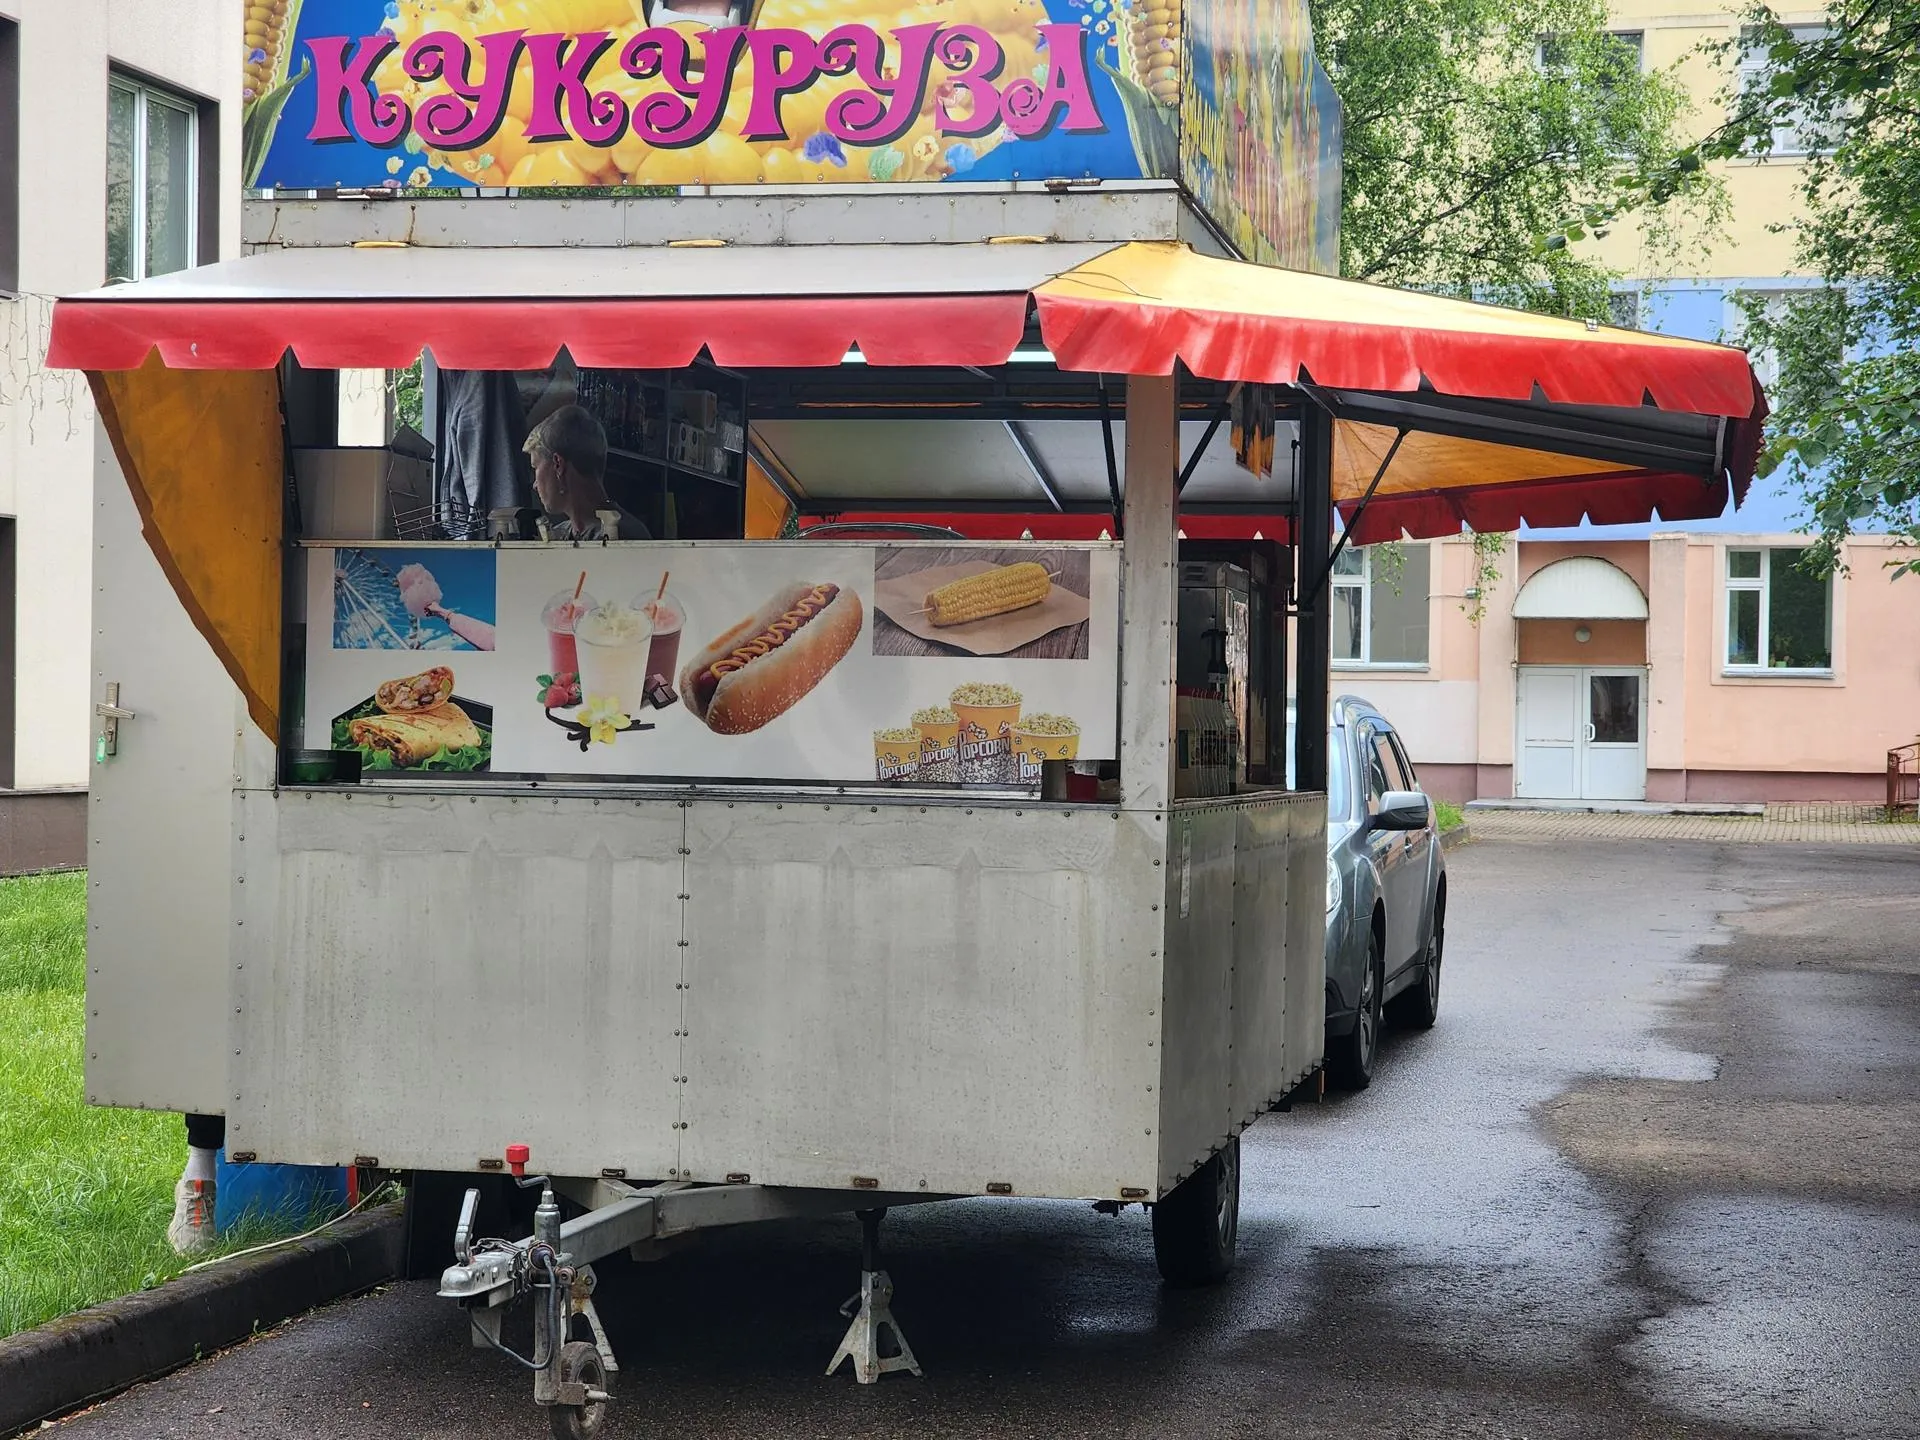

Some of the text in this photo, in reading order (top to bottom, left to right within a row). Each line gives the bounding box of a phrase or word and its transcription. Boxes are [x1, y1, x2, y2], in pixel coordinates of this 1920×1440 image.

[303, 21, 1106, 148] КУКУРУЗА
[958, 730, 1010, 761] POPCORN
[878, 757, 919, 781] POPCORN
